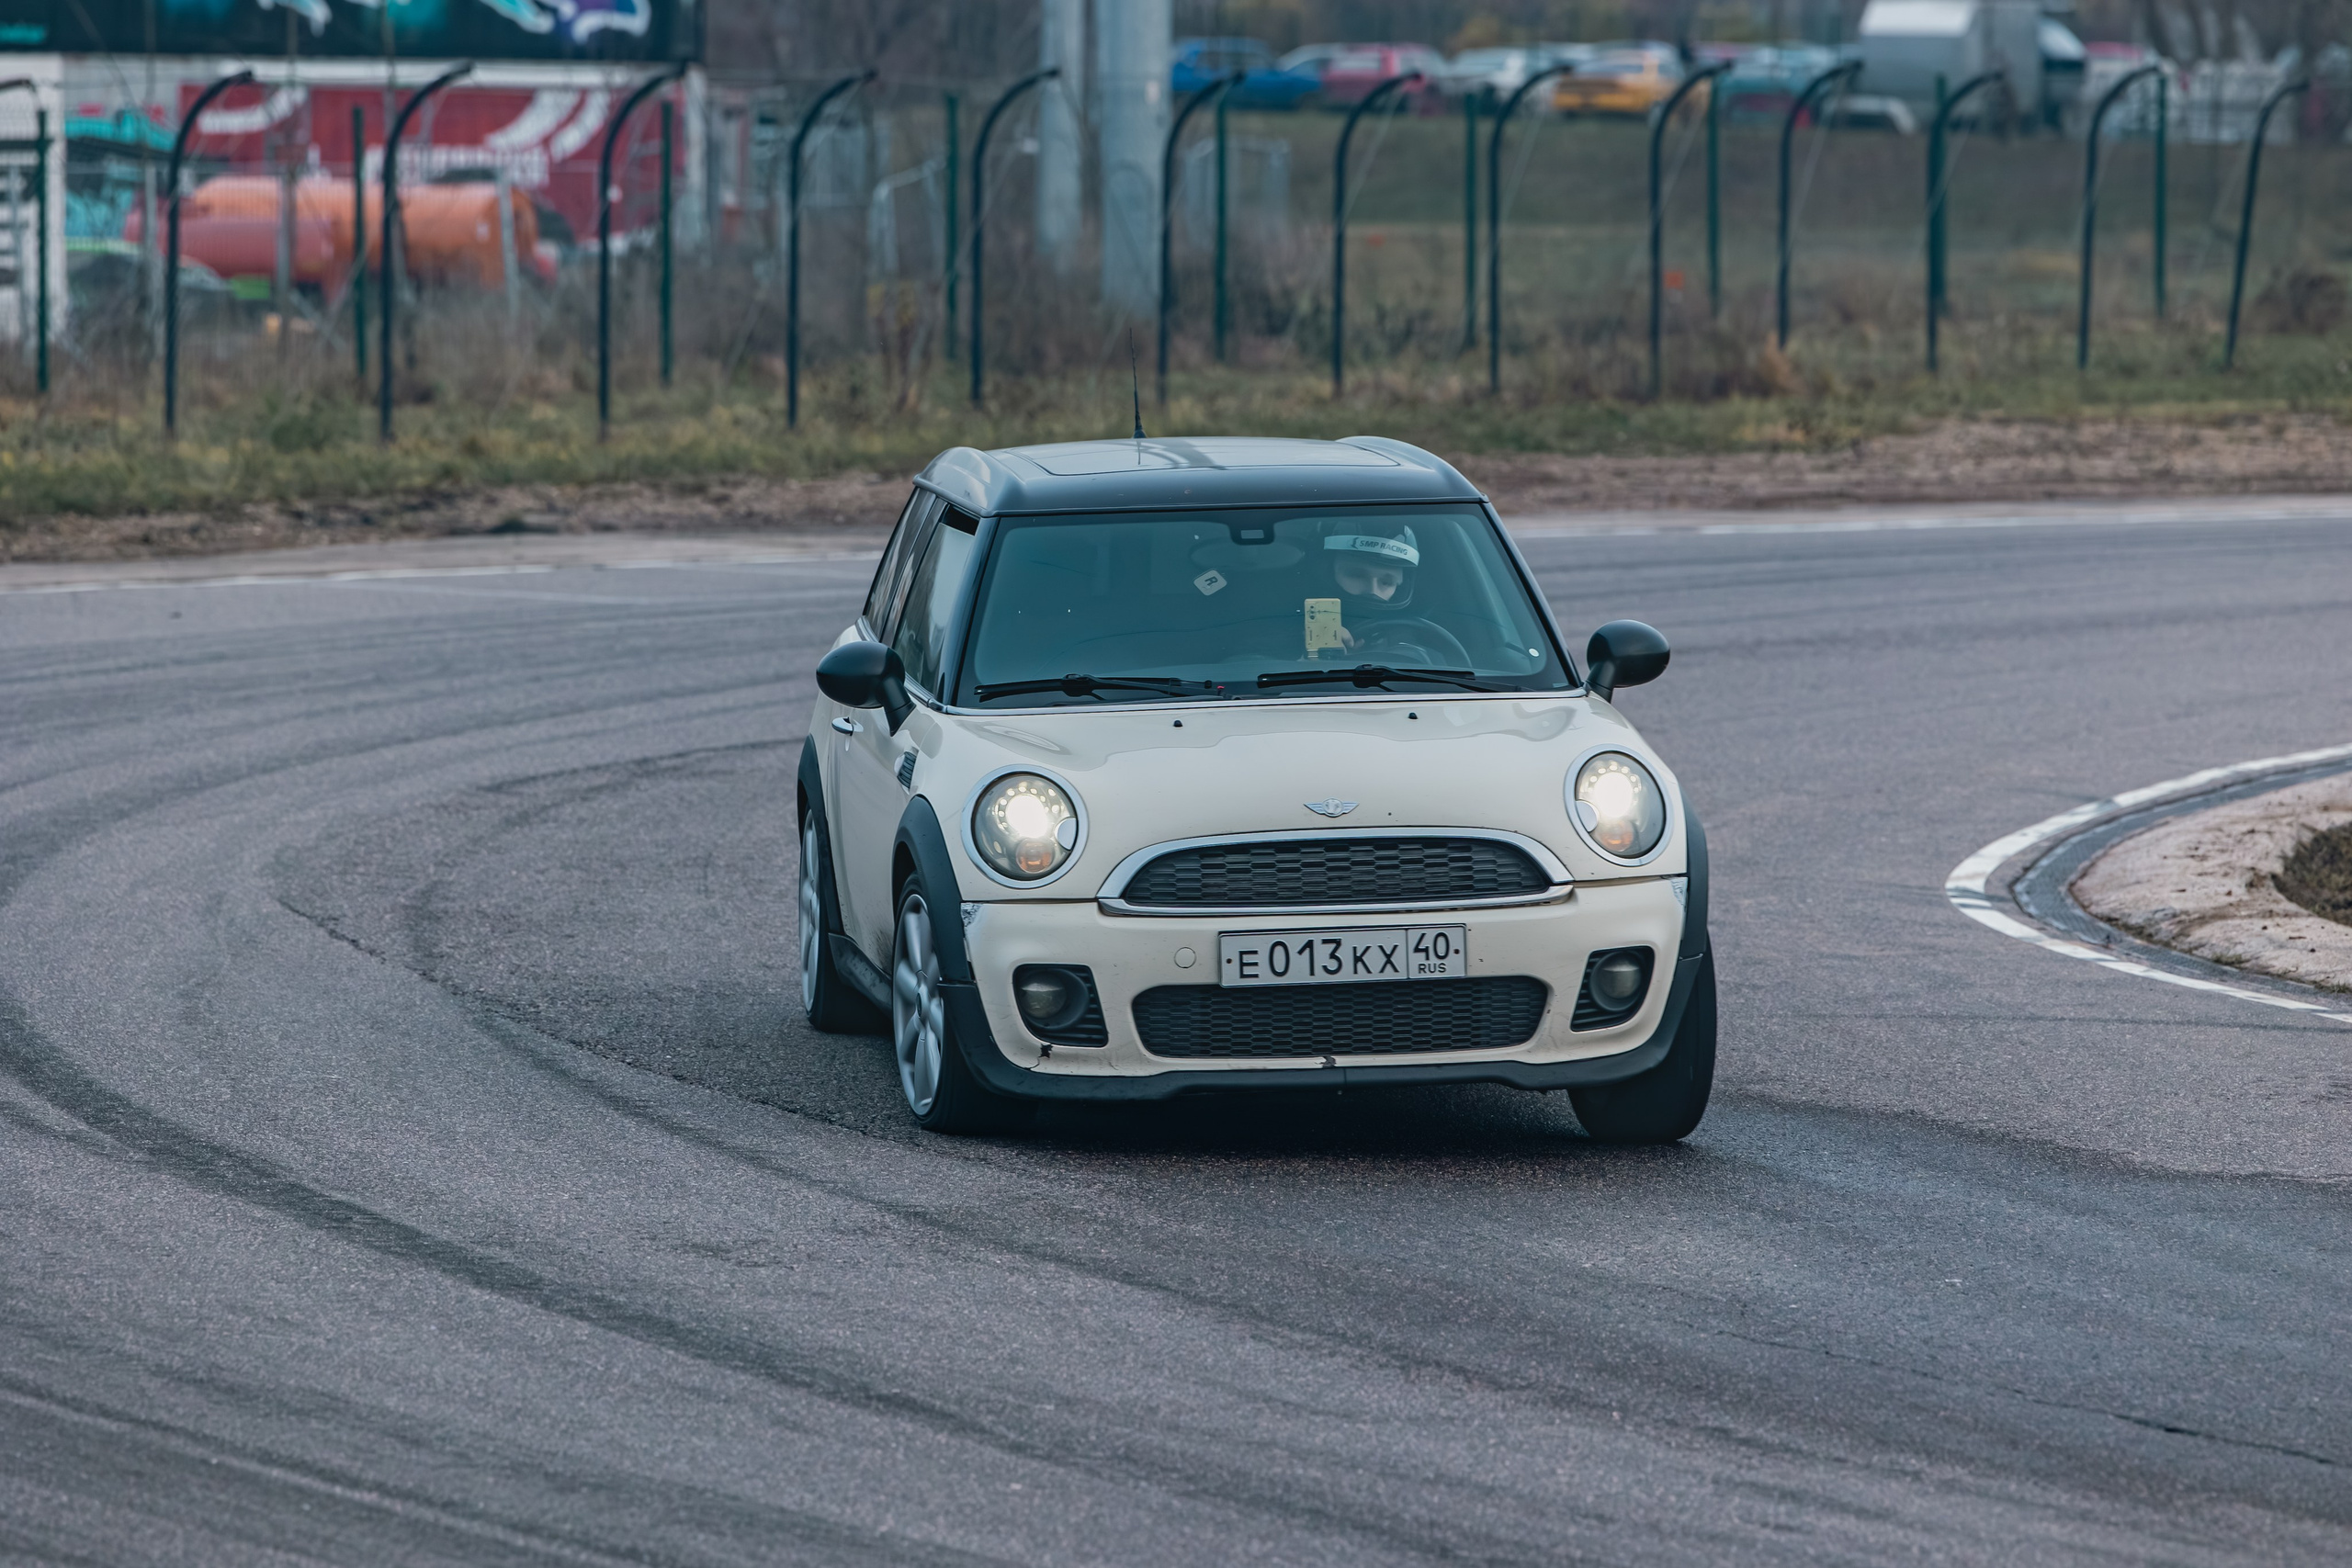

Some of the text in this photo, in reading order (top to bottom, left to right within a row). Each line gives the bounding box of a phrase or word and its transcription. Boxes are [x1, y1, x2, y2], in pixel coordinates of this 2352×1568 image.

[1360, 540, 1408, 555] SMP RACING
[1413, 931, 1450, 961] 40
[1418, 963, 1447, 974] RUS
